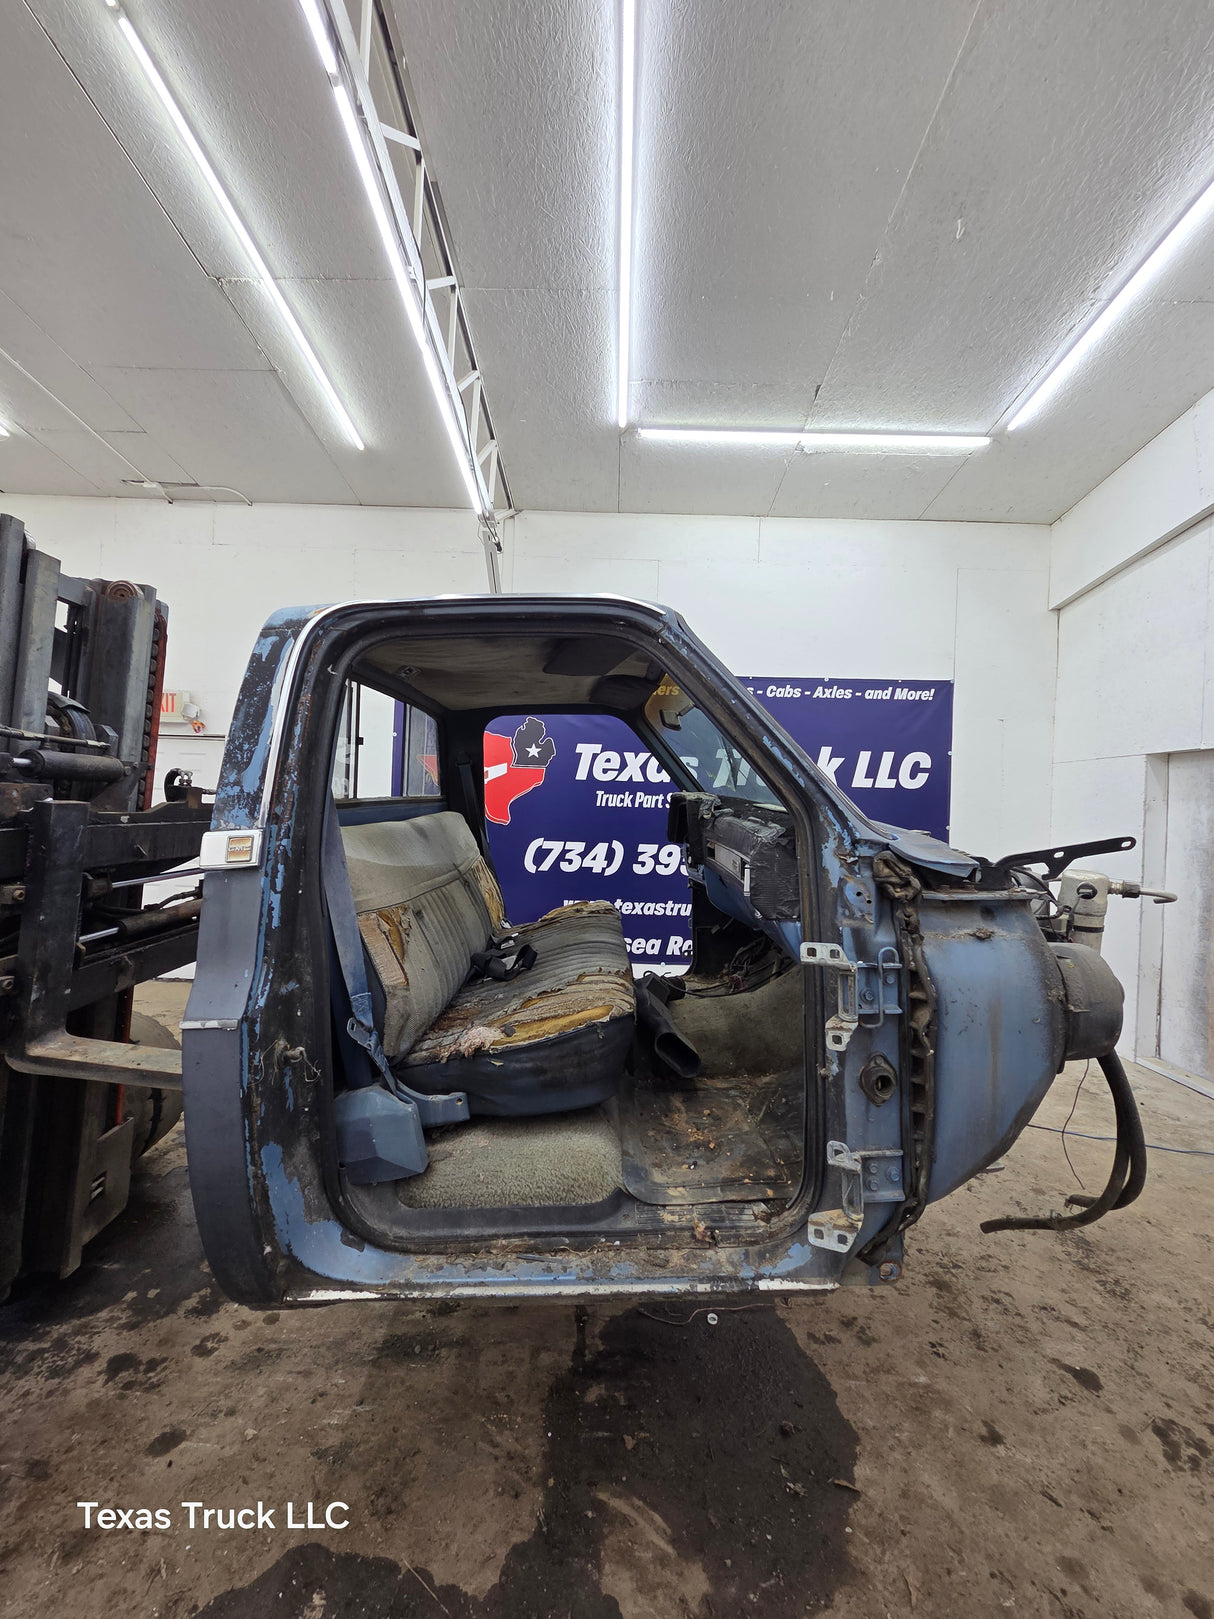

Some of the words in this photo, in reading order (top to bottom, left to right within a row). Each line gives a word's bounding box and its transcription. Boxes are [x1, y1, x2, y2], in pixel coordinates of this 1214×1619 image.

[766, 685, 801, 698] Cabs
[813, 685, 853, 699] Axles
[864, 687, 890, 700] and
[893, 688, 935, 700] More!
[851, 750, 932, 789] LLC
[596, 790, 633, 808] Truck
[634, 791, 665, 808] Part
[524, 837, 624, 876] (734)
